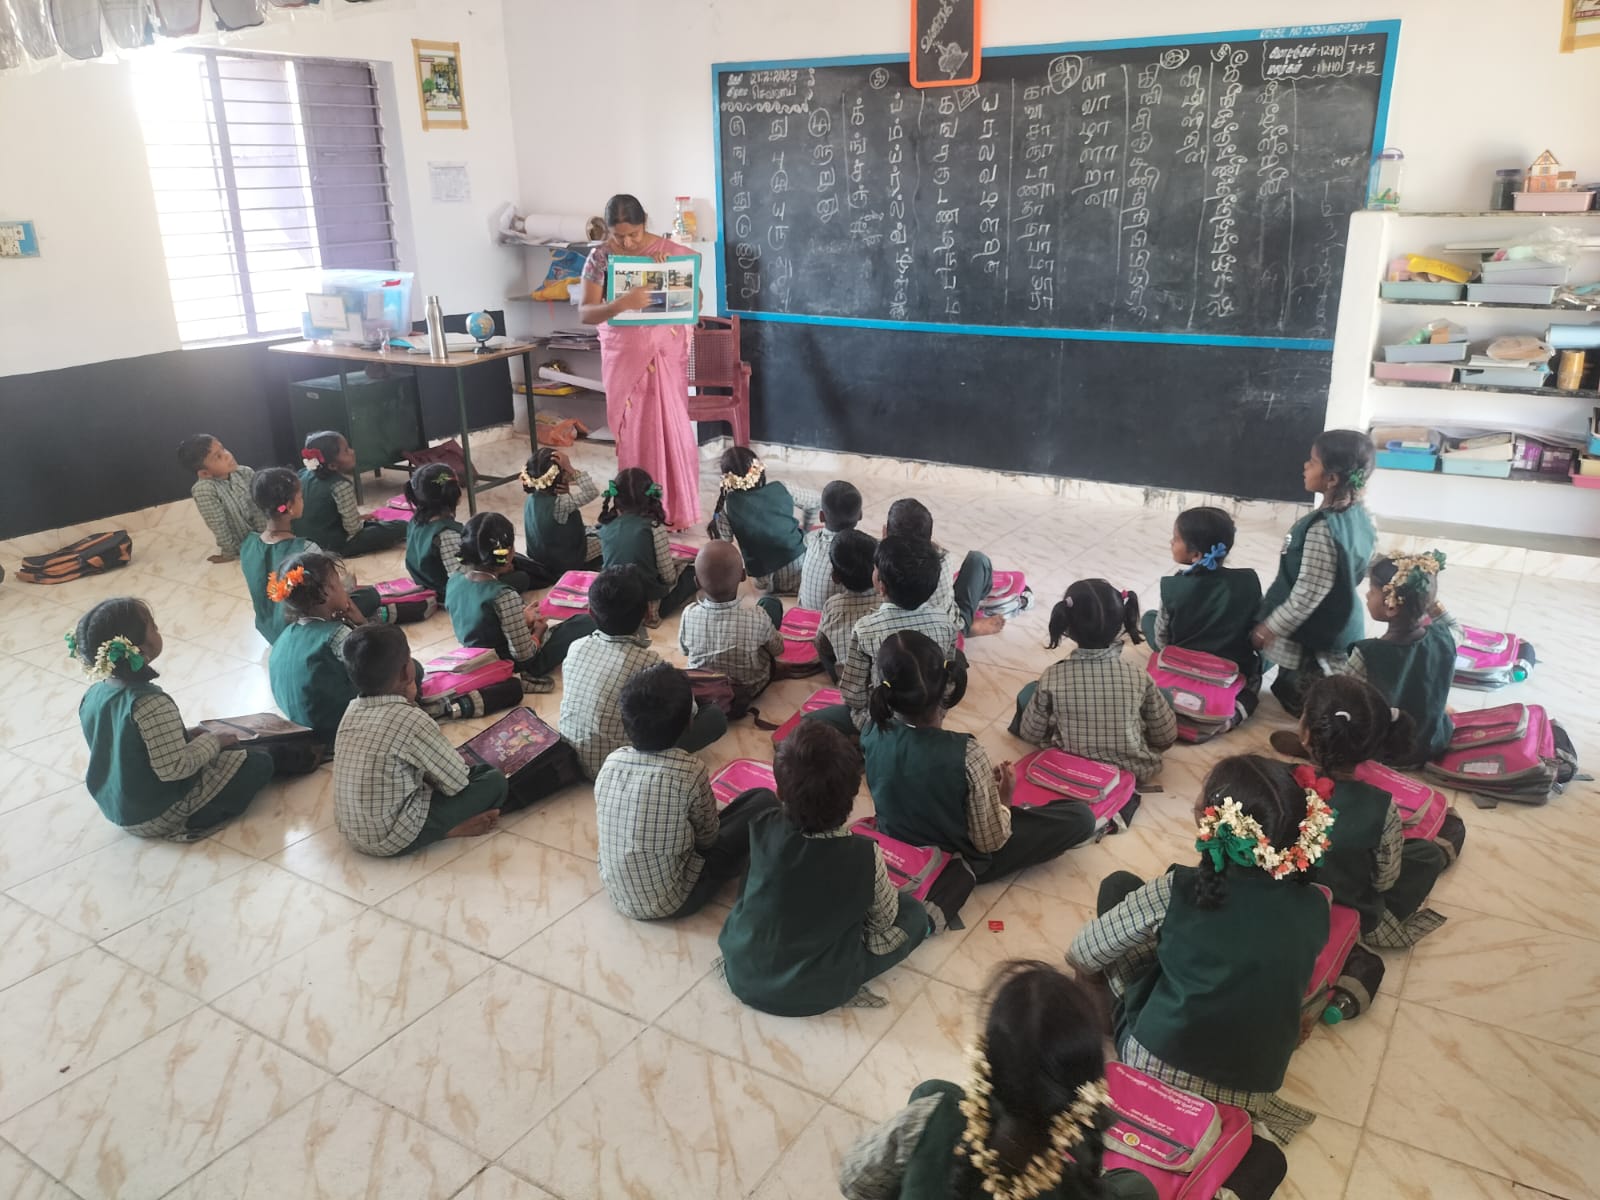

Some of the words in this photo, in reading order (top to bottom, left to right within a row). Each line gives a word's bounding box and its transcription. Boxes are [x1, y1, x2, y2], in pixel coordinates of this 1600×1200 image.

[1082, 72, 1107, 93] லா
[1138, 63, 1160, 89] கி
[982, 92, 999, 112] ய
[1024, 85, 1051, 100] கா
[938, 96, 955, 115] க
[1082, 95, 1111, 115] வா
[978, 118, 996, 140] ர
[1078, 120, 1112, 145] ழா
[933, 144, 949, 163] ச
[978, 144, 995, 162] ல
[979, 164, 998, 184] வ
[1025, 165, 1048, 179] டா
[937, 188, 948, 204] ட
[1017, 182, 1055, 199] ணா
[980, 191, 999, 213] ழ
[936, 208, 960, 224] ண
[1028, 240, 1051, 254] பா
[944, 275, 957, 290] ப
